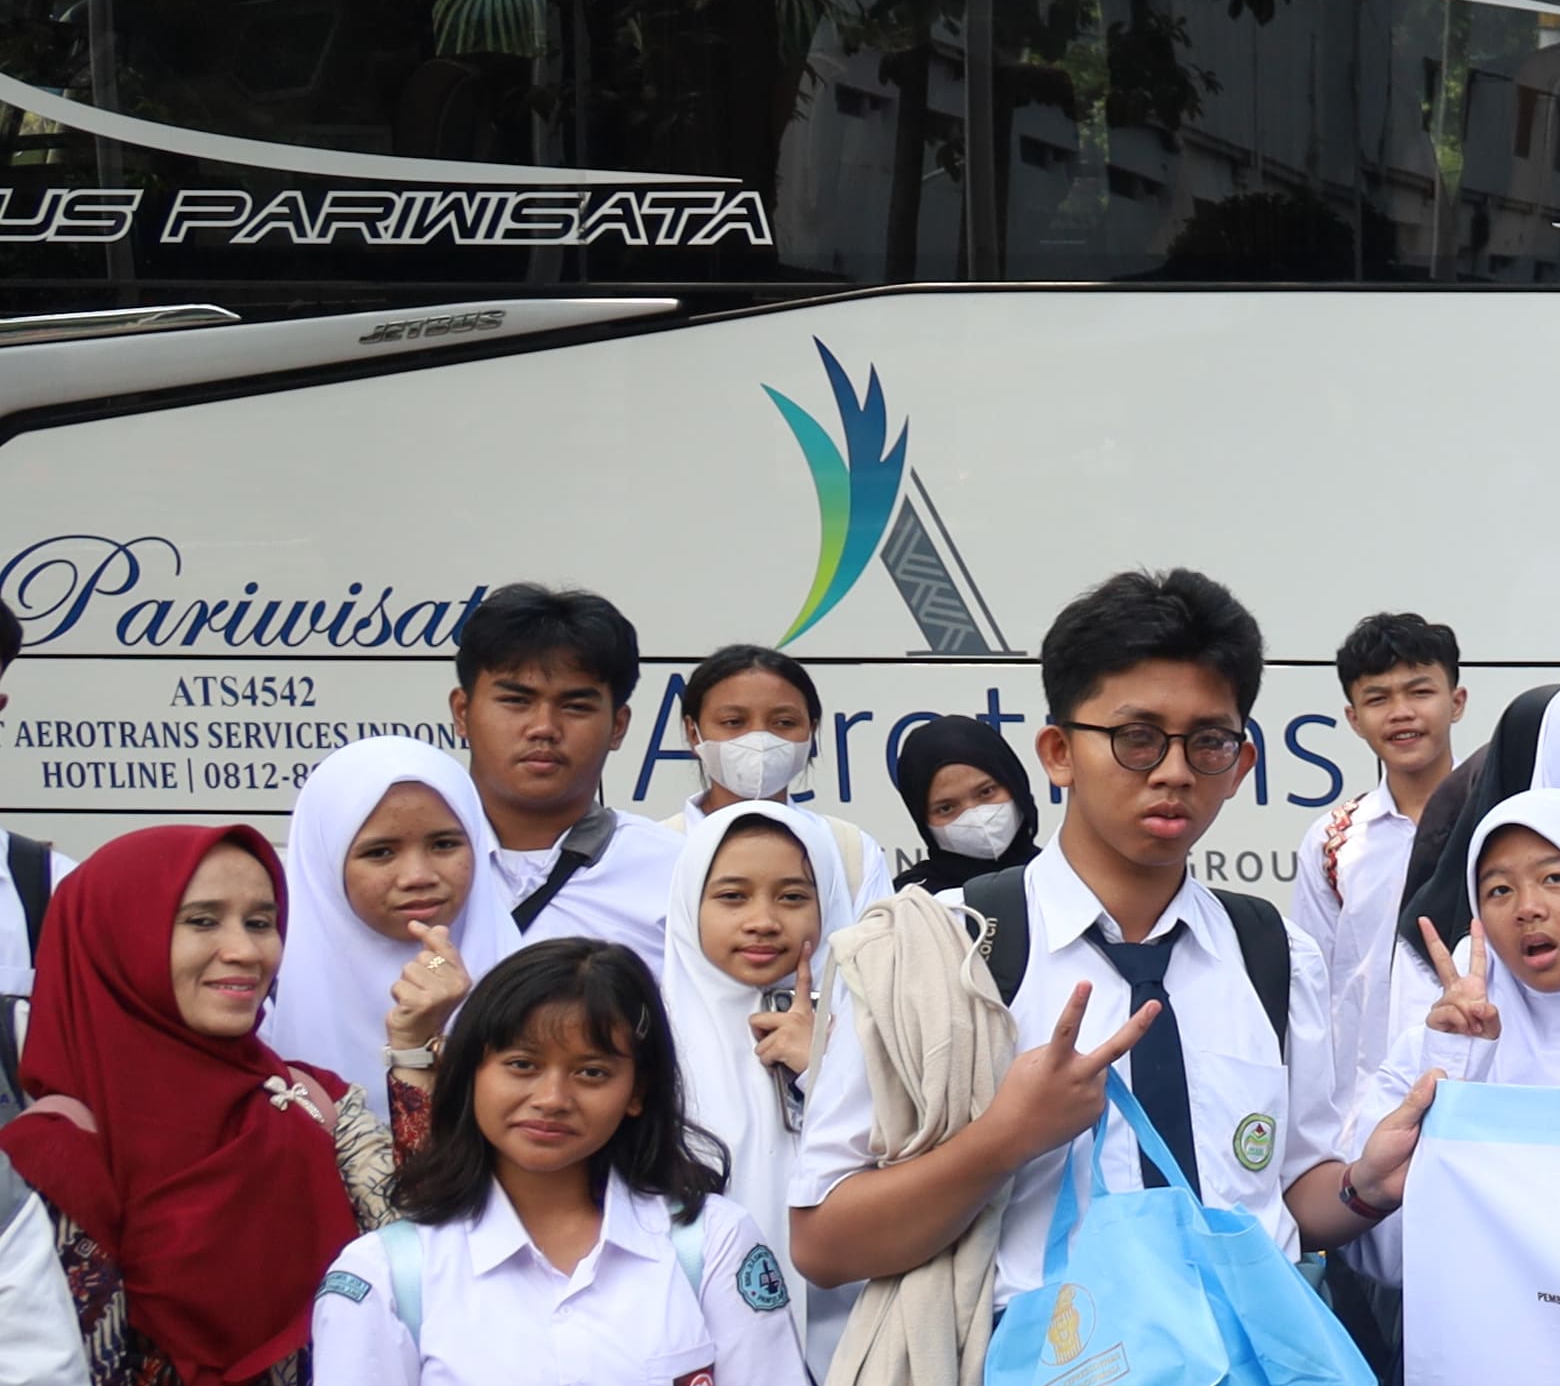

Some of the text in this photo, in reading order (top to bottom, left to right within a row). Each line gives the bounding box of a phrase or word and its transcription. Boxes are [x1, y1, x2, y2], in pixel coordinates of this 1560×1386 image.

[160, 190, 774, 246] PARIWISATA
[358, 310, 506, 345] JETBUS
[0, 534, 489, 649] Pariwisat
[170, 675, 316, 707] ATS4542
[14, 720, 199, 749] AEROTRANS
[207, 721, 349, 750] SERVICES
[42, 761, 178, 789] HOTLINE
